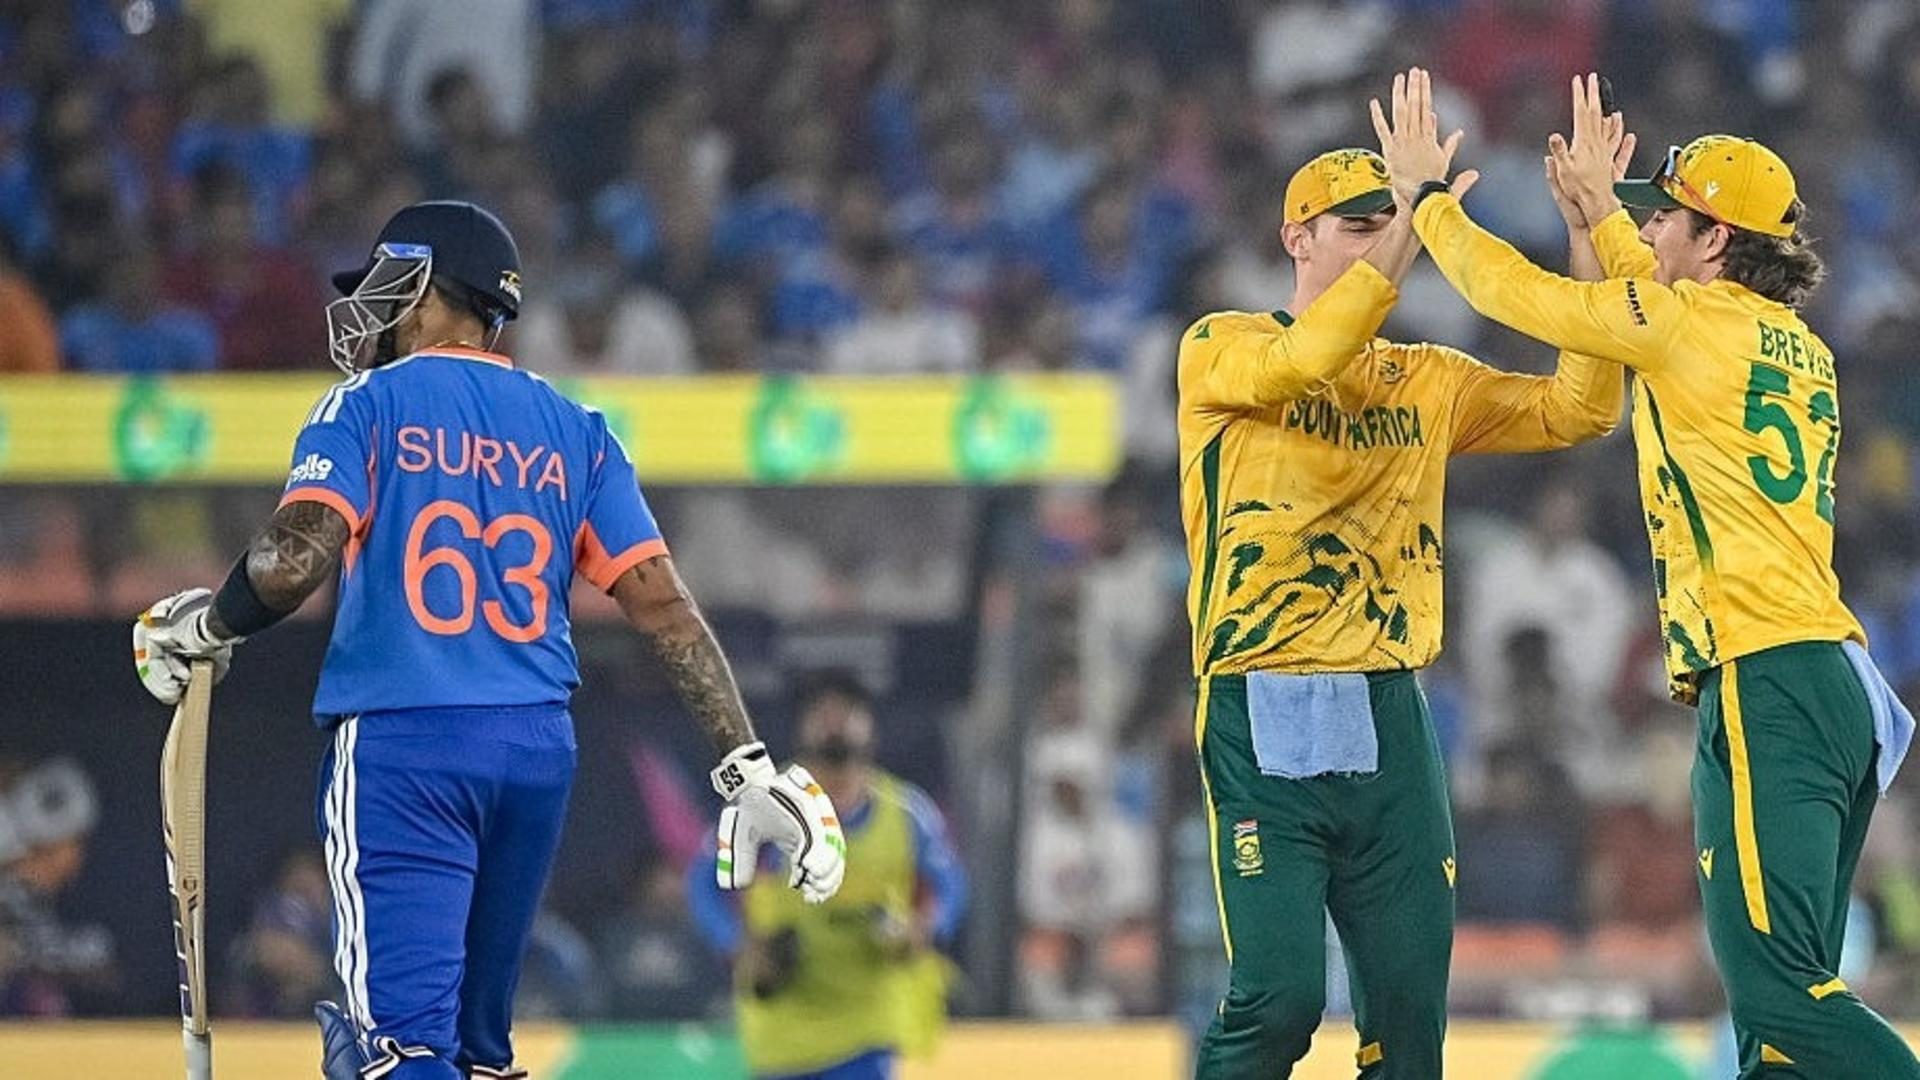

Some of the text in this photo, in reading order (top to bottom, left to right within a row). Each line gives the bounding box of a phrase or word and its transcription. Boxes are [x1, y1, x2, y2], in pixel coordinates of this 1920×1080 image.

[1351, 404, 1424, 450] AFRICA
[397, 427, 567, 501] SURYA
[404, 500, 553, 643] 63
[719, 762, 745, 793] SS
